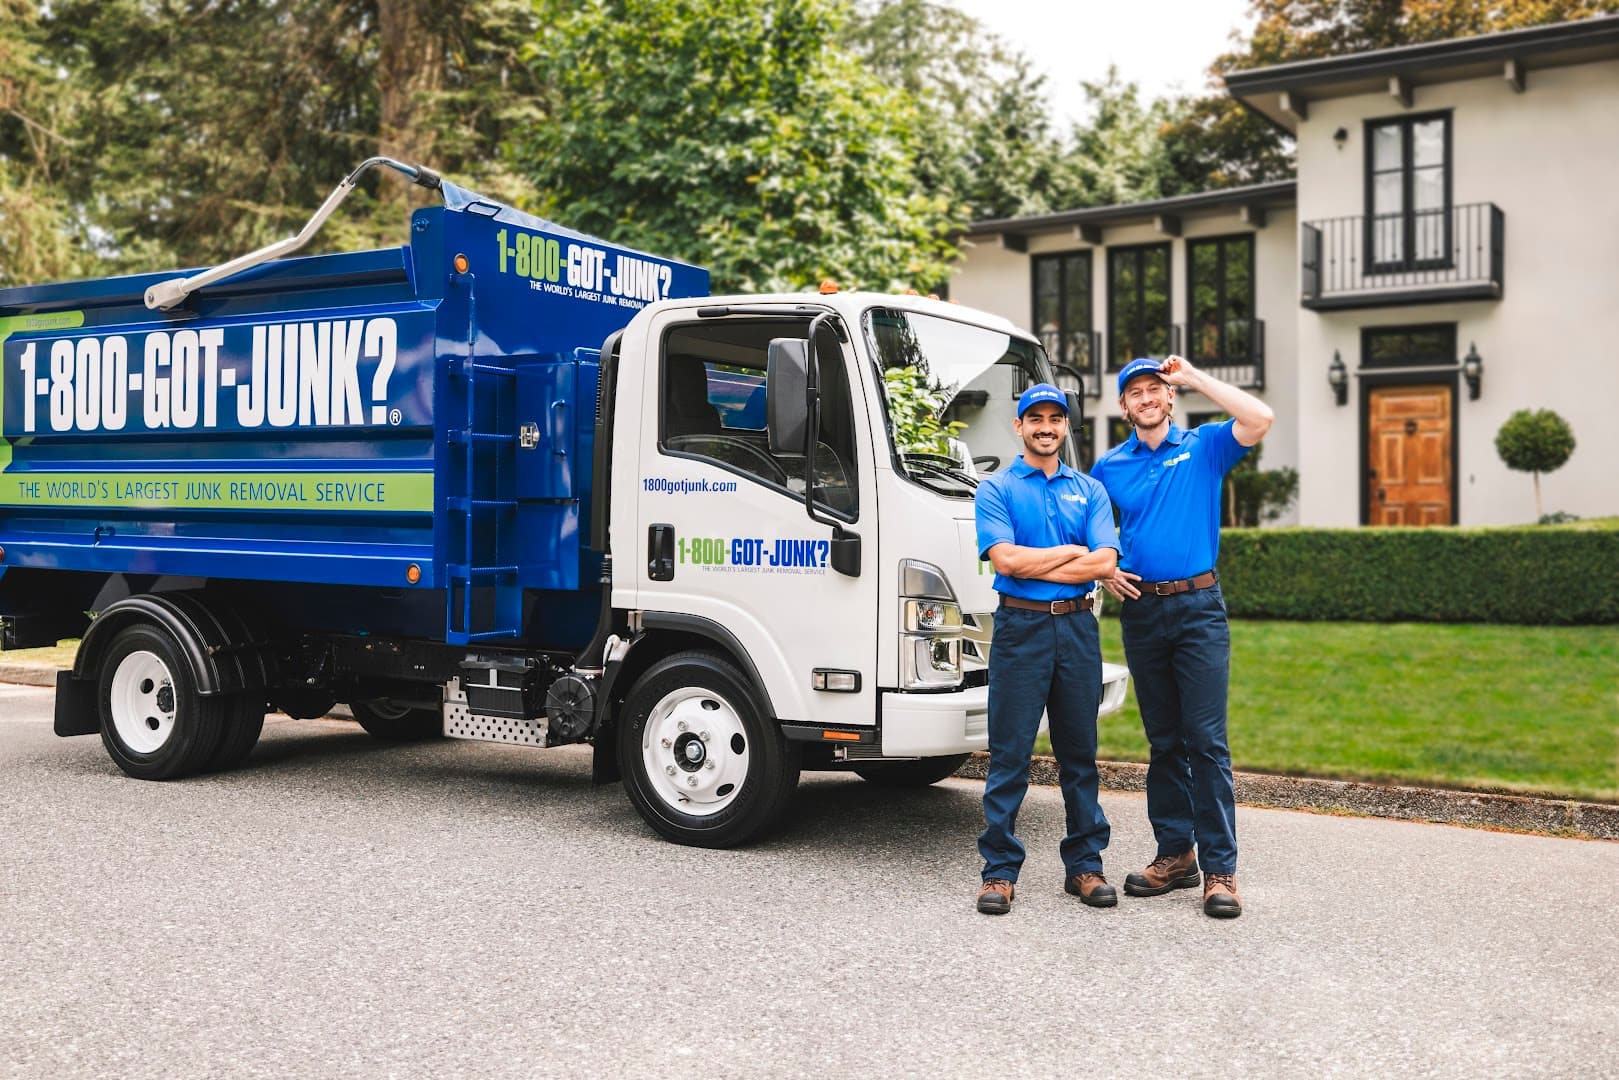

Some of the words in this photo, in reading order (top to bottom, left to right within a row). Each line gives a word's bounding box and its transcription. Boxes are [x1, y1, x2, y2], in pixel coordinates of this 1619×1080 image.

[497, 228, 672, 302] 1-800-GOT-JUNK?
[530, 280, 542, 291] THE
[543, 283, 573, 297] WORLD'S
[574, 289, 601, 302] LARGEST
[602, 294, 617, 306] JUNK
[18, 481, 41, 498] THE
[46, 480, 109, 499] WORLD'S
[116, 481, 179, 500] LARGEST
[185, 481, 222, 501] JUNK
[230, 482, 308, 502] REMOVAL
[316, 482, 386, 502] SERVICE
[642, 478, 737, 494] 1800gotjunk.com
[678, 537, 830, 568] 1-800-GOT-JUNK?
